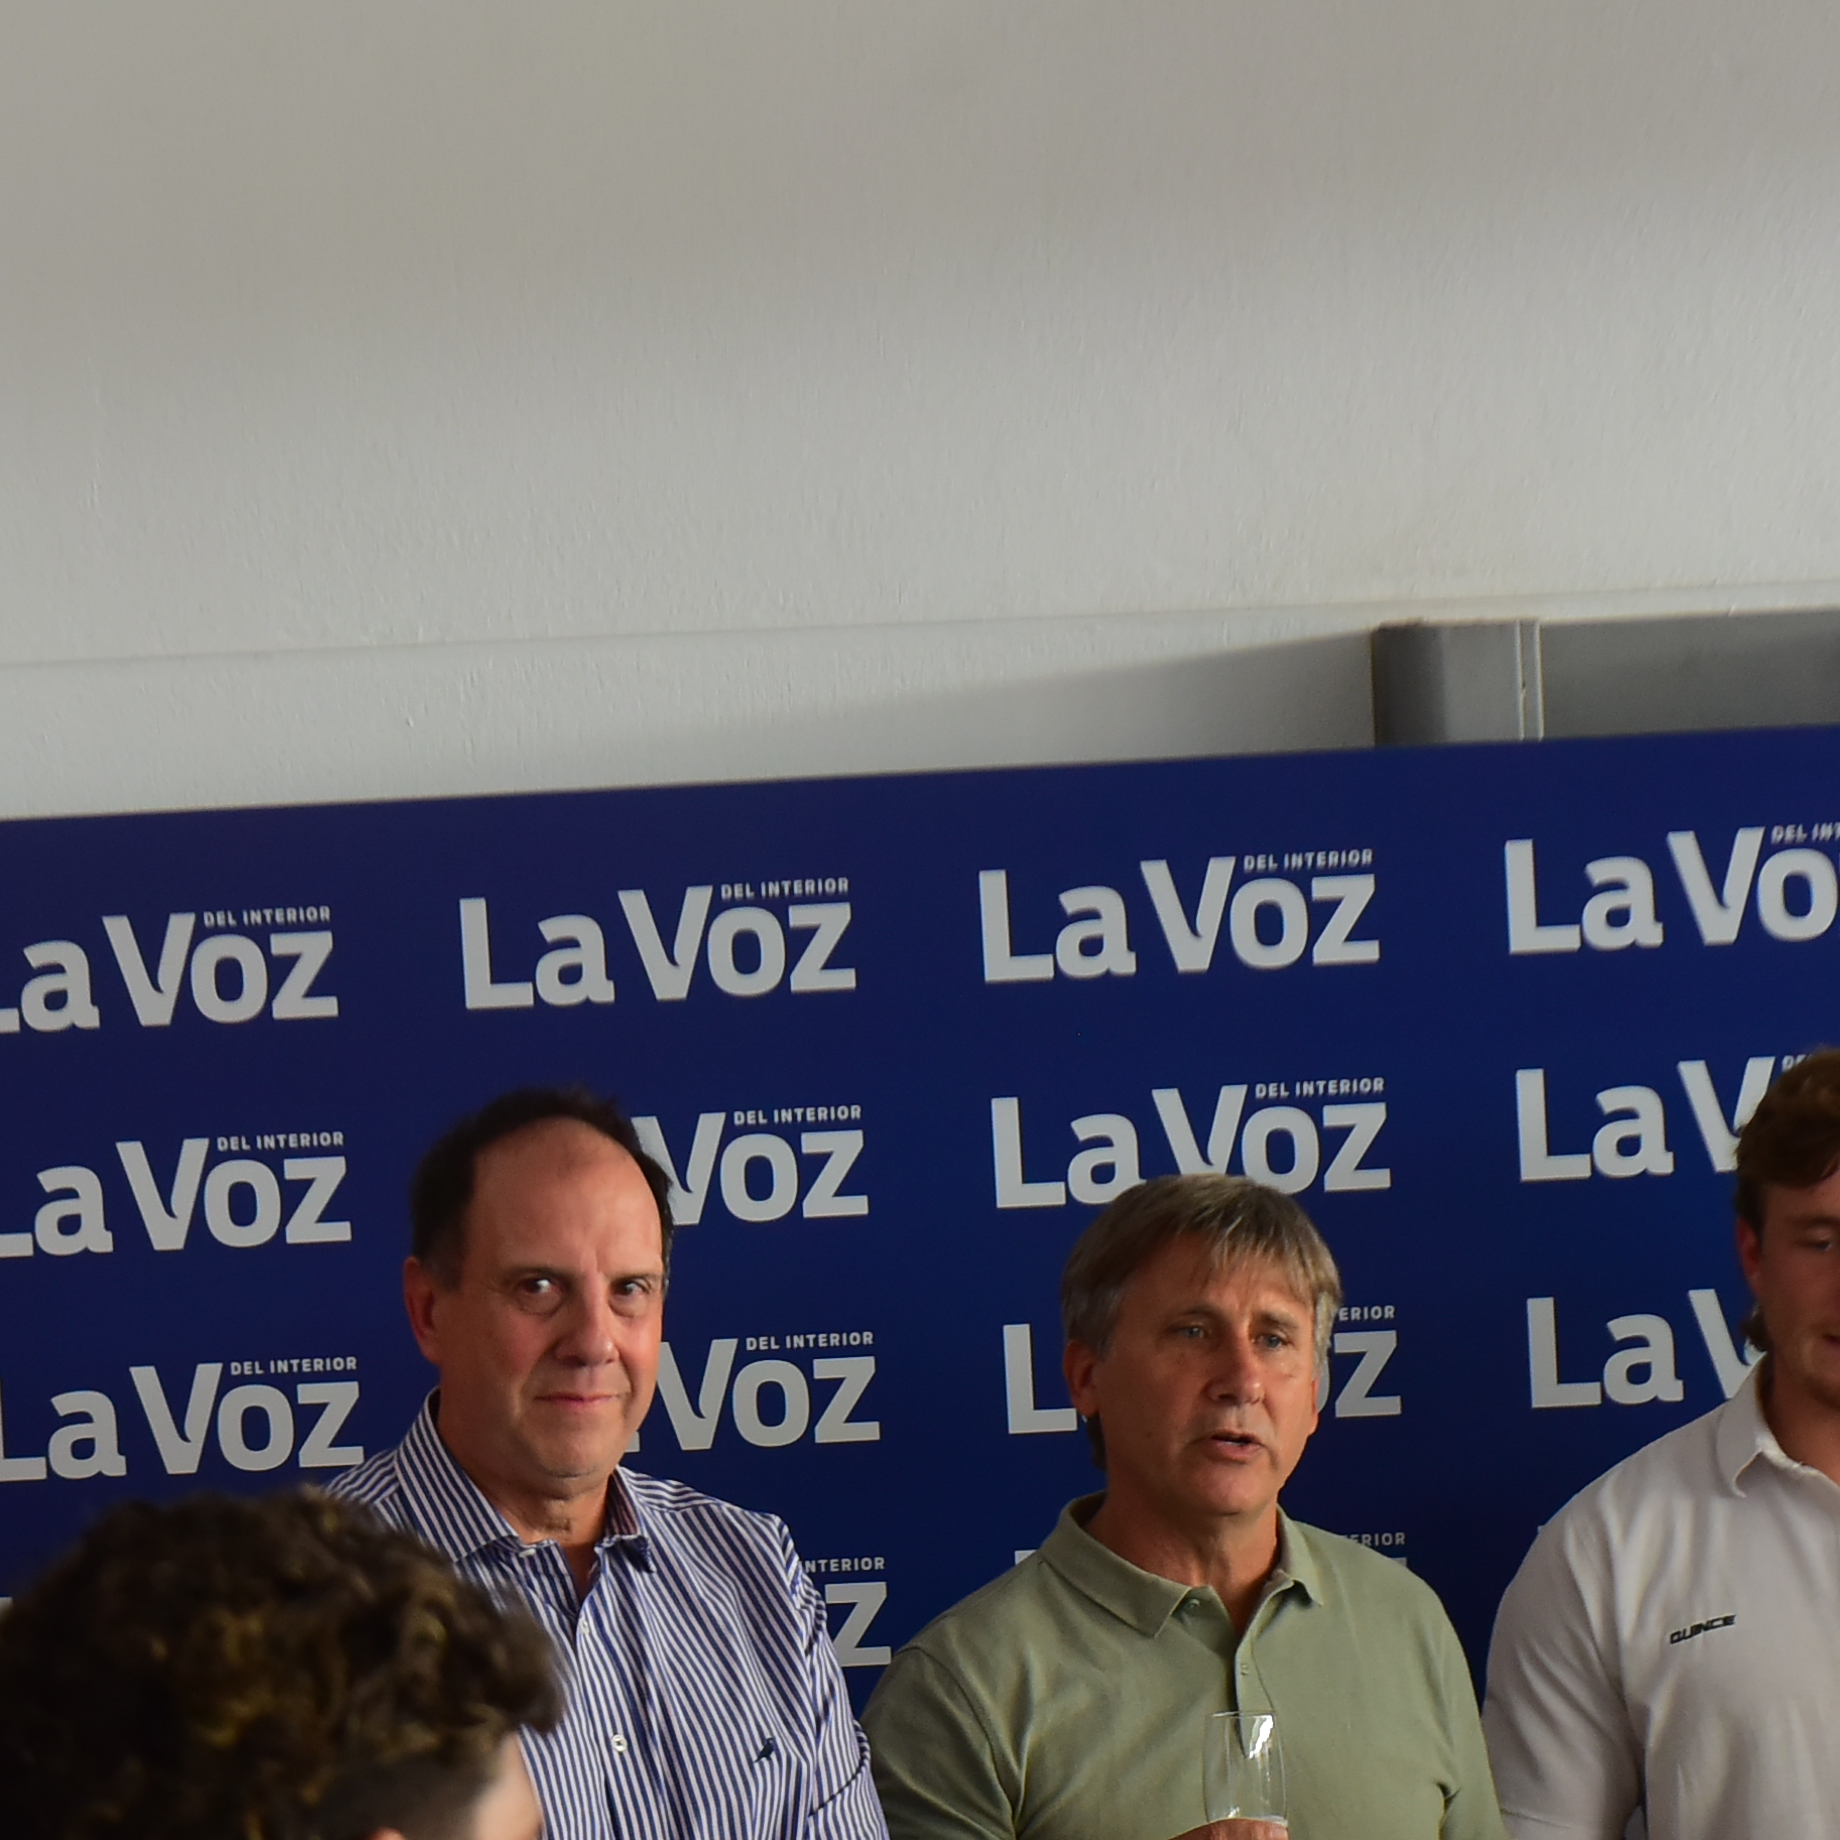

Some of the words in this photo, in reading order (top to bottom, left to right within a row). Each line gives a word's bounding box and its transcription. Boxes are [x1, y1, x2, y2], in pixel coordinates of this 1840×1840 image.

[1772, 825, 1807, 842] DEL
[1244, 855, 1277, 870] DEL
[1285, 849, 1372, 868] INTERIOR
[722, 884, 754, 899] DEL
[762, 878, 848, 897] INTERIOR
[204, 912, 236, 926] DEL
[244, 907, 327, 925] INTERIOR
[1256, 1083, 1289, 1098] DEL
[1296, 1078, 1383, 1096] INTERIOR
[734, 1110, 767, 1125] DEL
[774, 1105, 861, 1123] INTERIOR
[218, 1137, 250, 1151] DEL
[257, 1132, 343, 1149] INTERIOR
[1338, 1305, 1395, 1322] ERIOR
[747, 1337, 779, 1350] DEL
[786, 1332, 873, 1348] INTERIOR
[231, 1362, 263, 1375] DEL
[270, 1357, 356, 1373] INTERIOR
